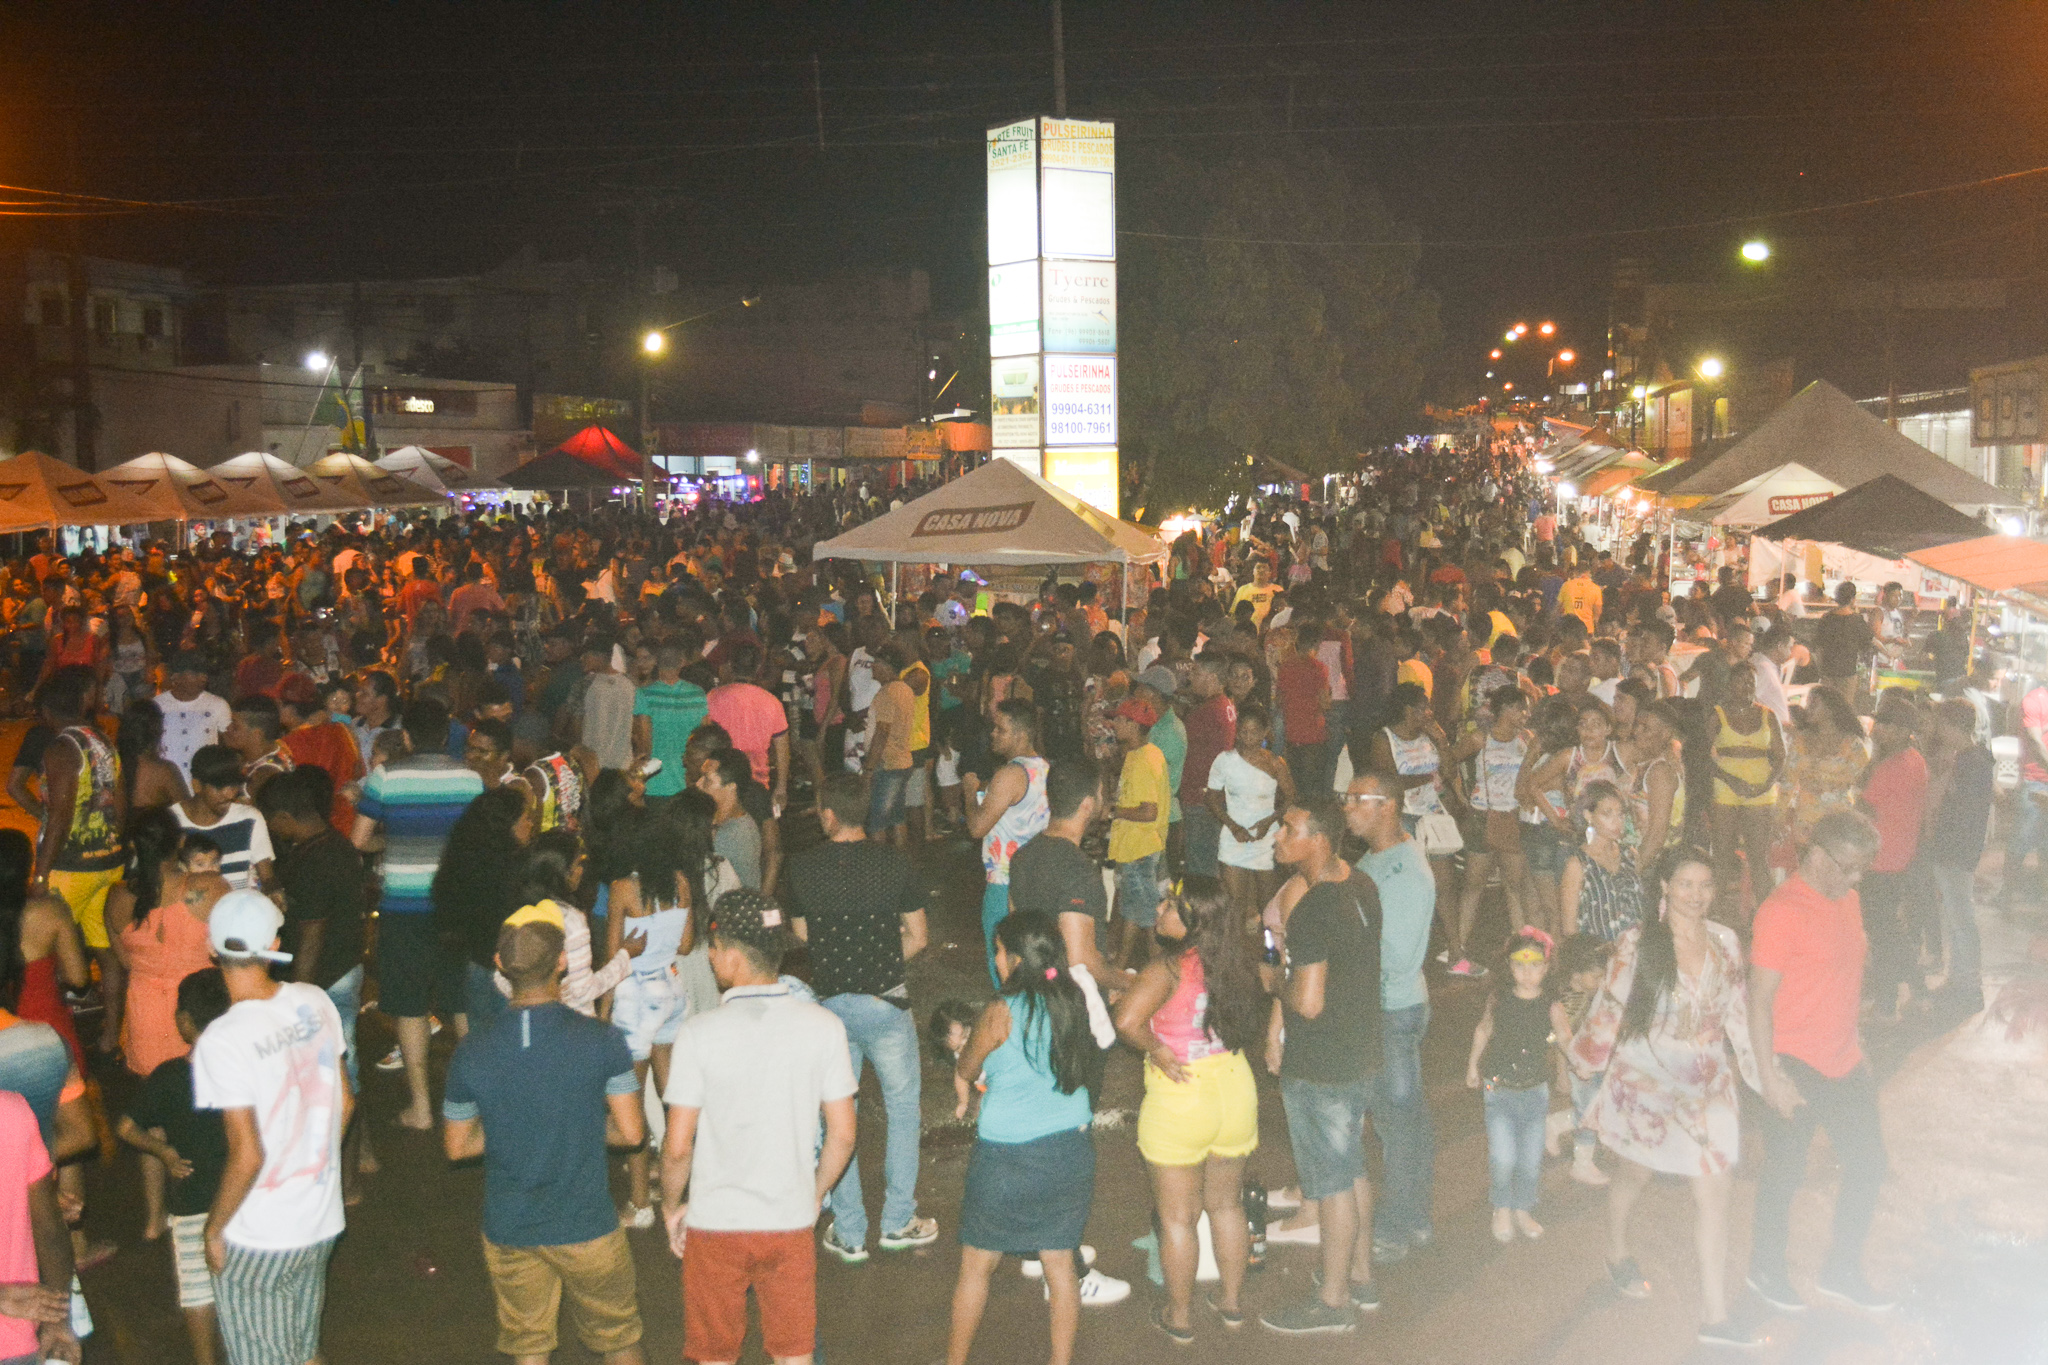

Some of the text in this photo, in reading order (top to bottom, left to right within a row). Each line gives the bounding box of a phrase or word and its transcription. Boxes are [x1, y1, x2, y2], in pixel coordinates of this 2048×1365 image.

[1012, 126, 1033, 140] FRUIT
[1044, 123, 1112, 140] PULSEIRINHA
[992, 144, 1017, 159] SANTA
[1049, 268, 1109, 291] Tyerre
[1051, 364, 1110, 379] PULSEIRINHA
[1050, 383, 1074, 393] GRUDES
[1081, 384, 1111, 394] PESCADOS
[1052, 403, 1111, 415] 99904-6311
[1051, 422, 1111, 434] 98100-7961
[1771, 498, 1801, 511] CASA
[923, 509, 1022, 531] CASA NOVA
